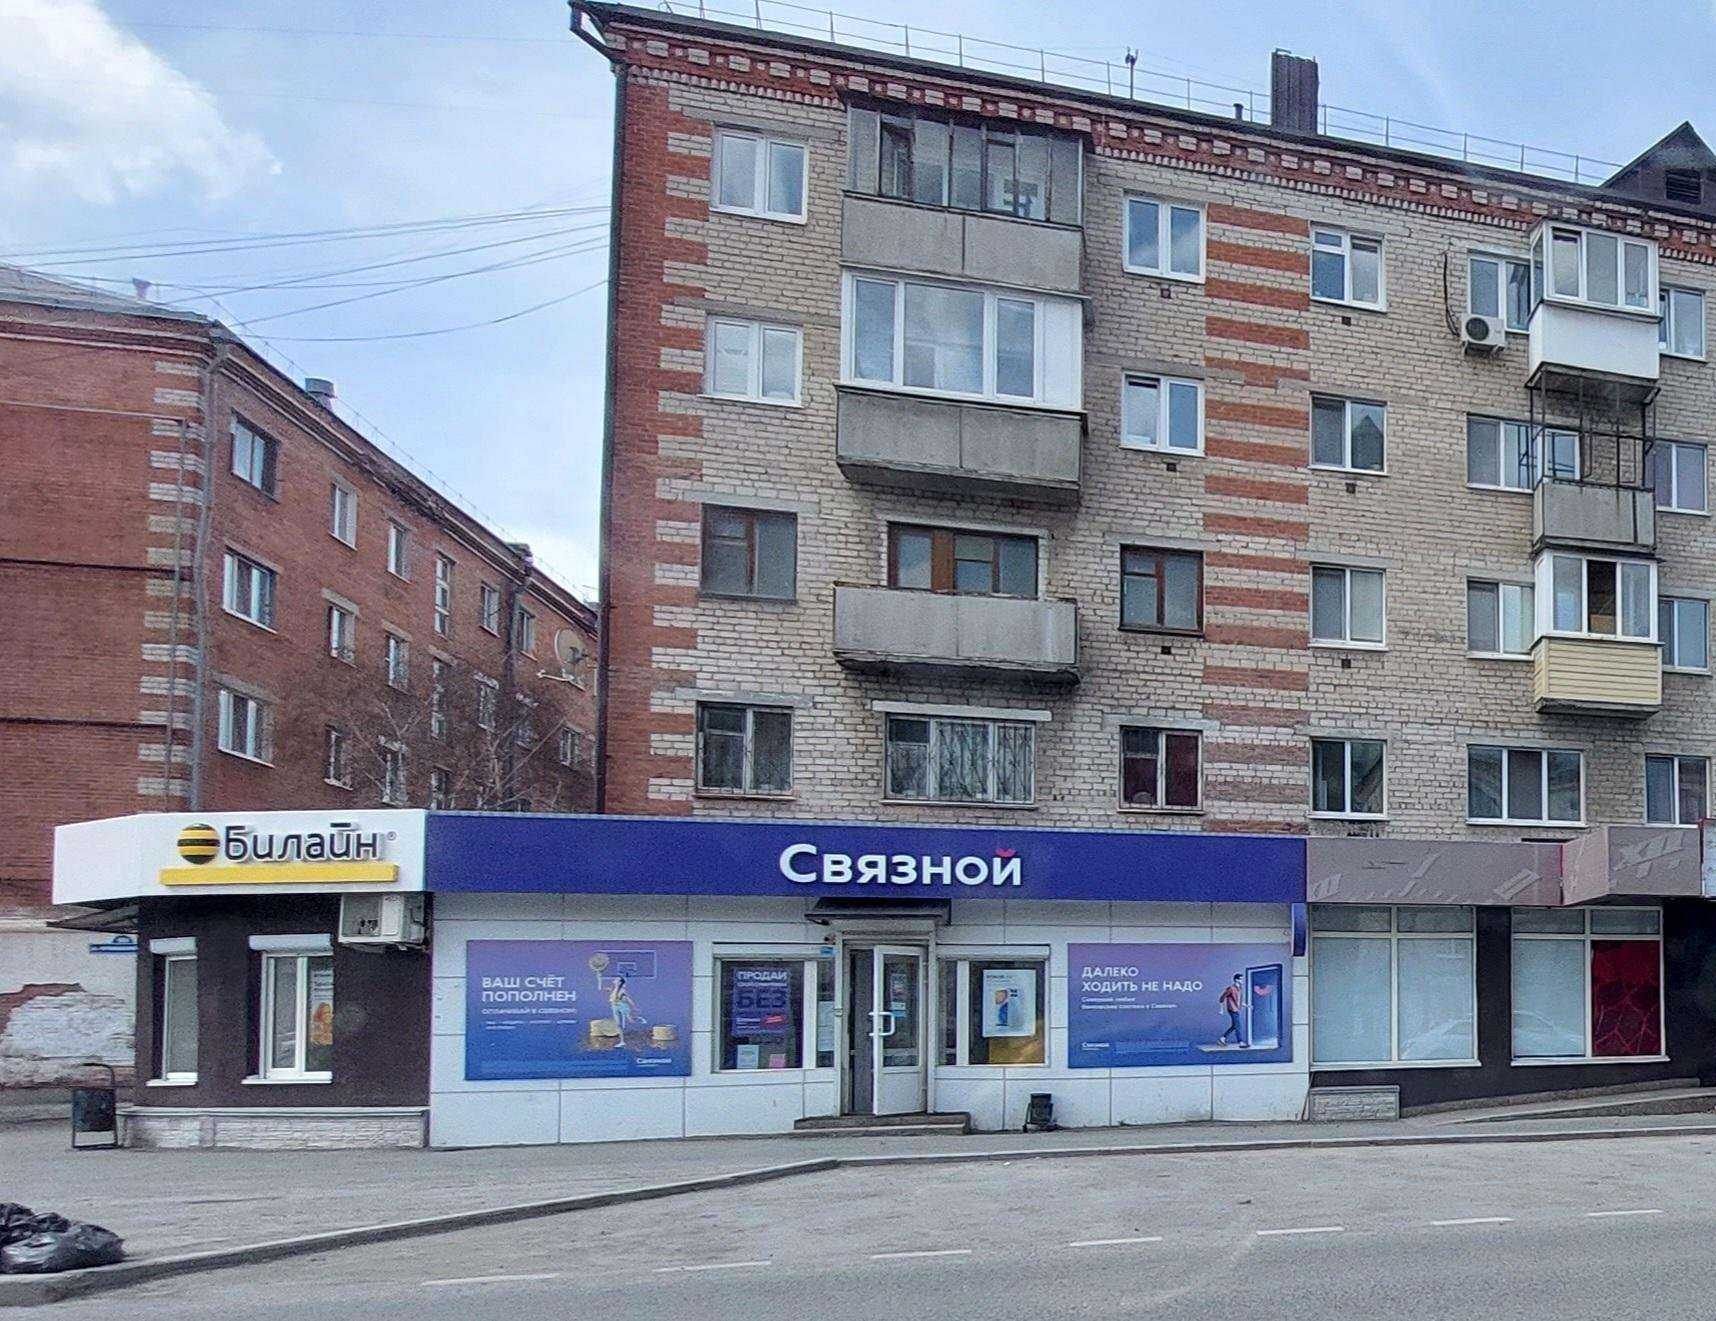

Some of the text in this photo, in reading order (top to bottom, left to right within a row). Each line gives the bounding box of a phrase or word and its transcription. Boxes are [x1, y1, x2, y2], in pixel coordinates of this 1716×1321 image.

[1081, 966, 1140, 979] ДАЛЕКО
[482, 976, 521, 988] ВАШ
[1081, 980, 1204, 993] ХОДИТЬ НЕ НАДО
[481, 990, 577, 1002] ПОПОЛНЕН
